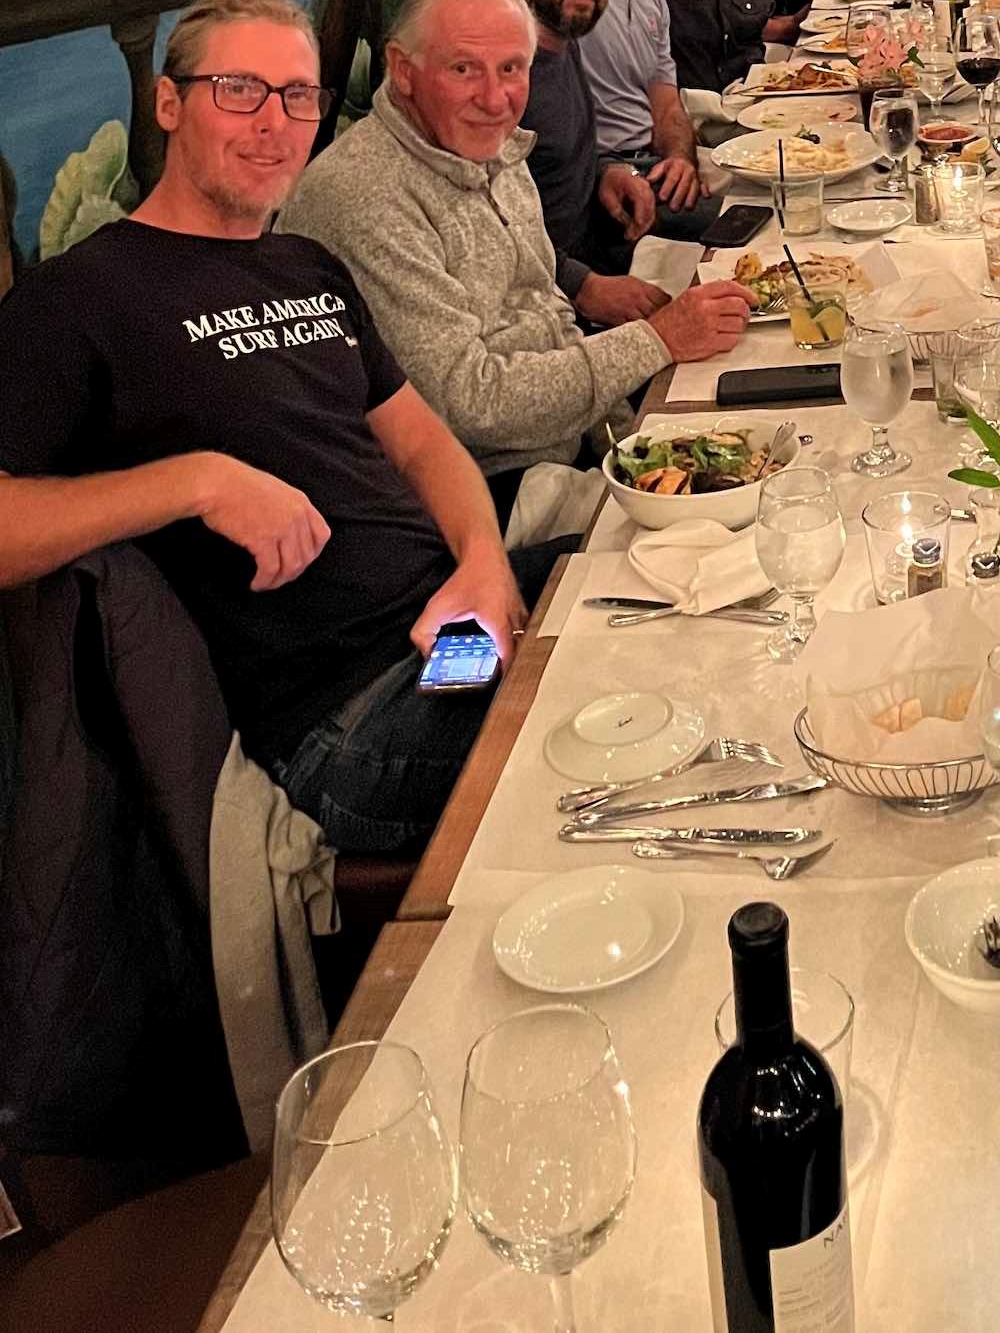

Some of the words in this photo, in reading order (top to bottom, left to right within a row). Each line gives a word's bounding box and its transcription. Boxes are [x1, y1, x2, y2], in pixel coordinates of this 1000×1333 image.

[182, 306, 260, 343] MAKE
[218, 328, 280, 360] SURF
[283, 317, 346, 348] AGAIN
